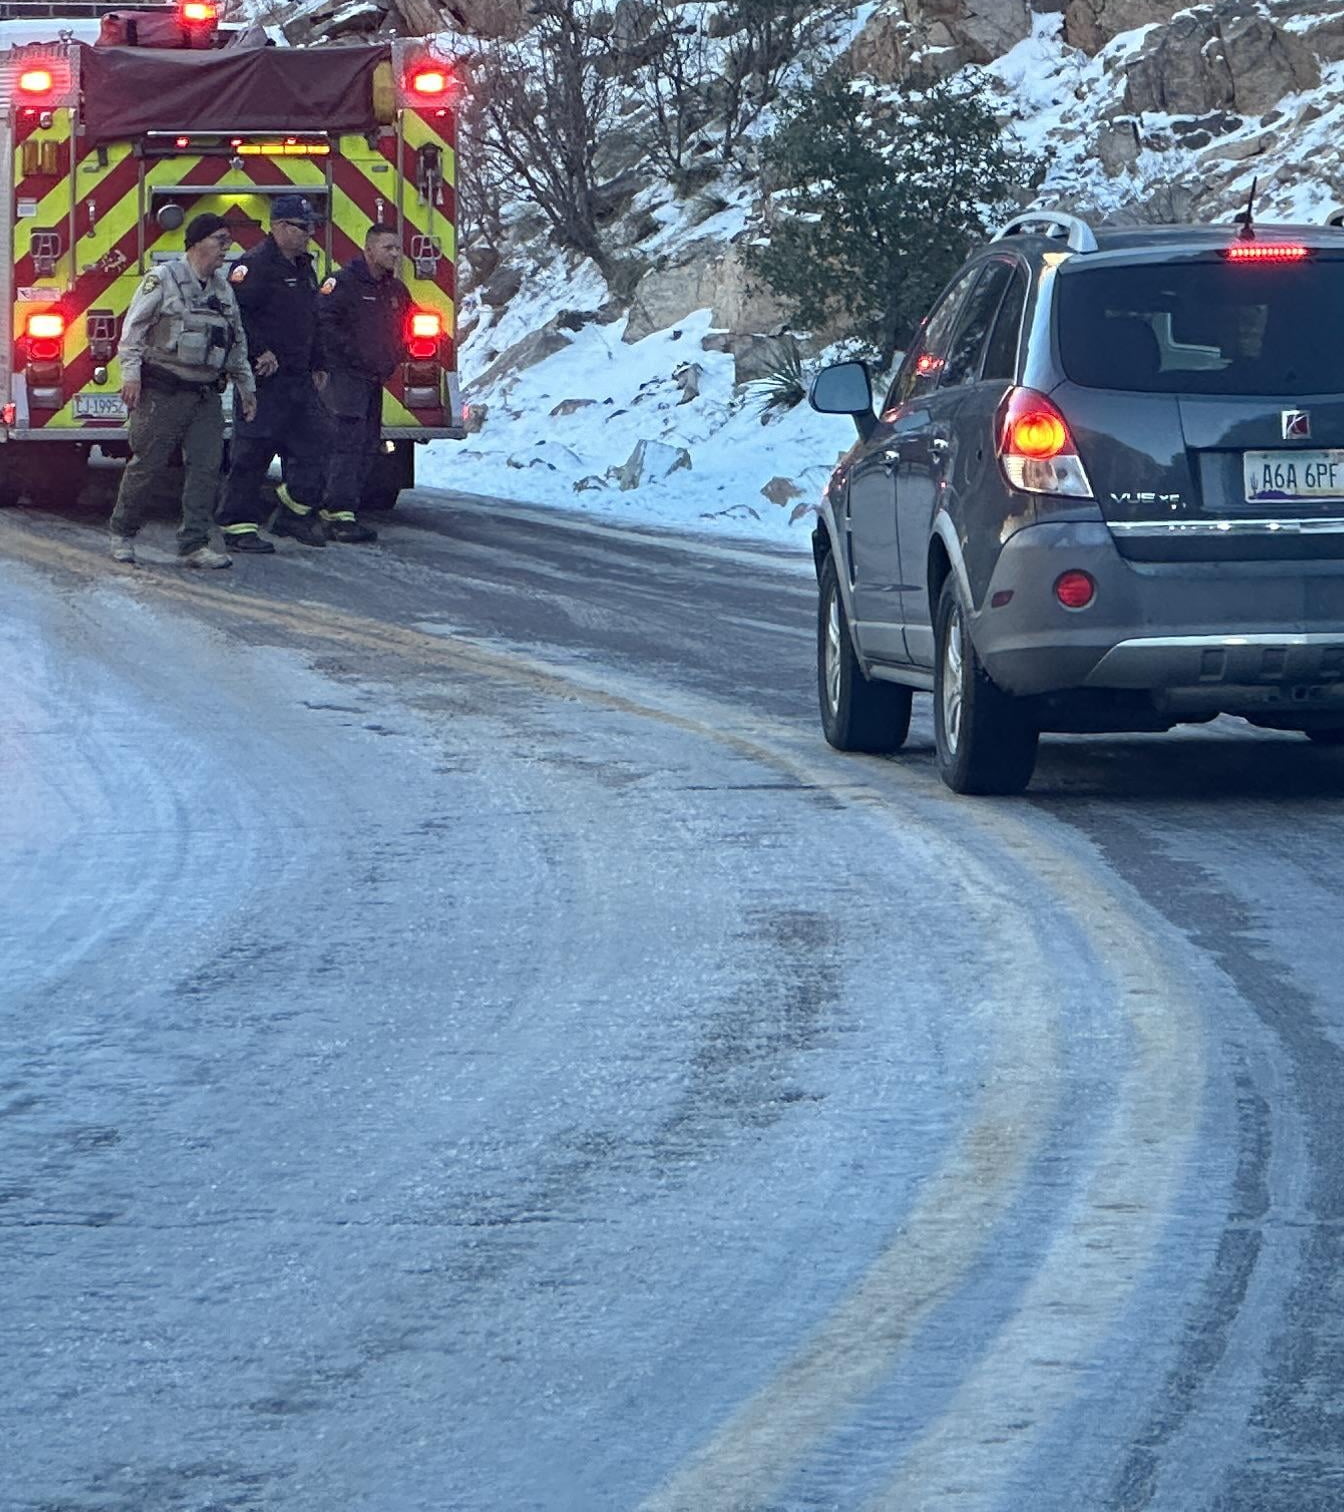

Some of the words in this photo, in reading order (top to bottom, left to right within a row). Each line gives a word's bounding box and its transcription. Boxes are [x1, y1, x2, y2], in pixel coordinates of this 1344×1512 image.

[1262, 463, 1297, 489] A6A
[1305, 463, 1338, 488] 6PF
[1110, 492, 1156, 504] VUE
